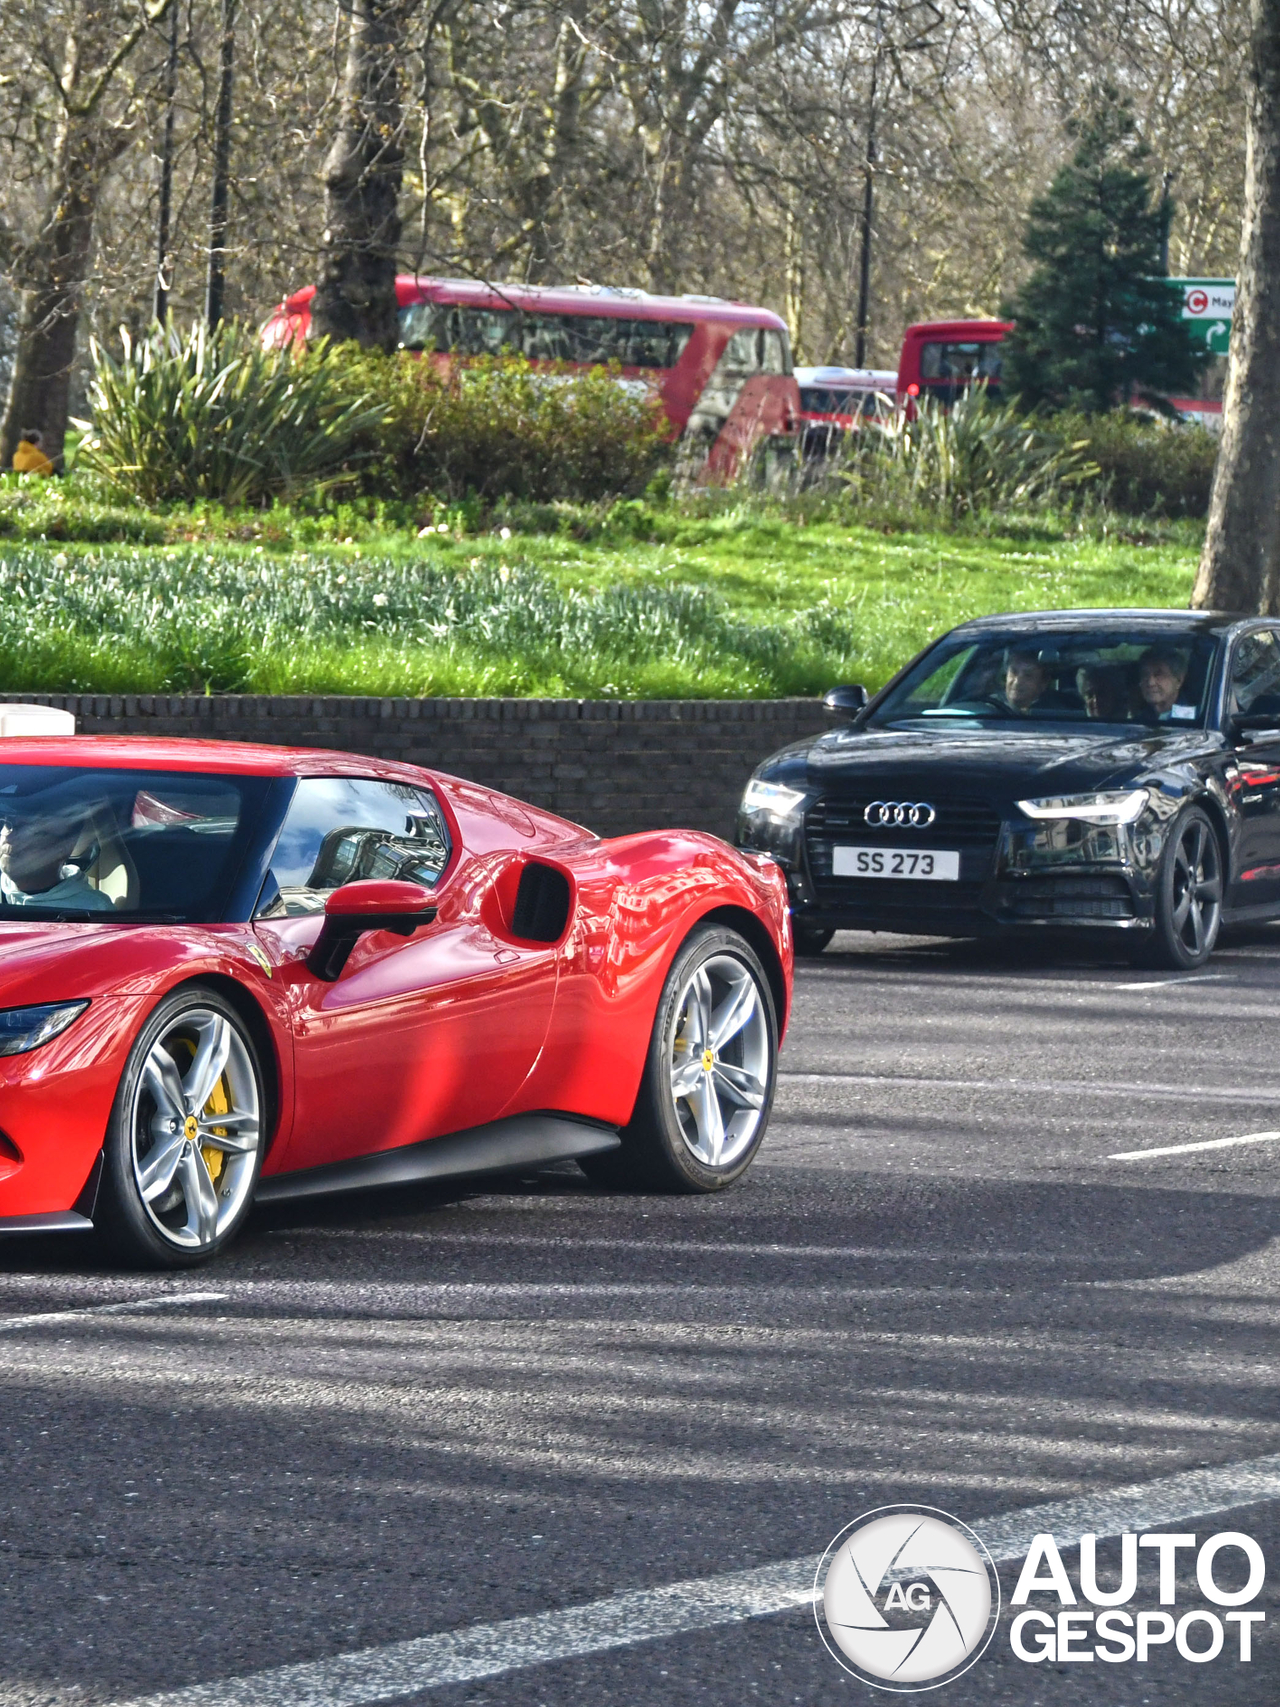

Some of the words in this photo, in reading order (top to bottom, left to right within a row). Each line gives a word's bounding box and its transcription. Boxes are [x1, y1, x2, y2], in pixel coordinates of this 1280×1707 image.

[1212, 297, 1233, 309] May
[857, 852, 884, 873] SS
[891, 853, 934, 875] 273
